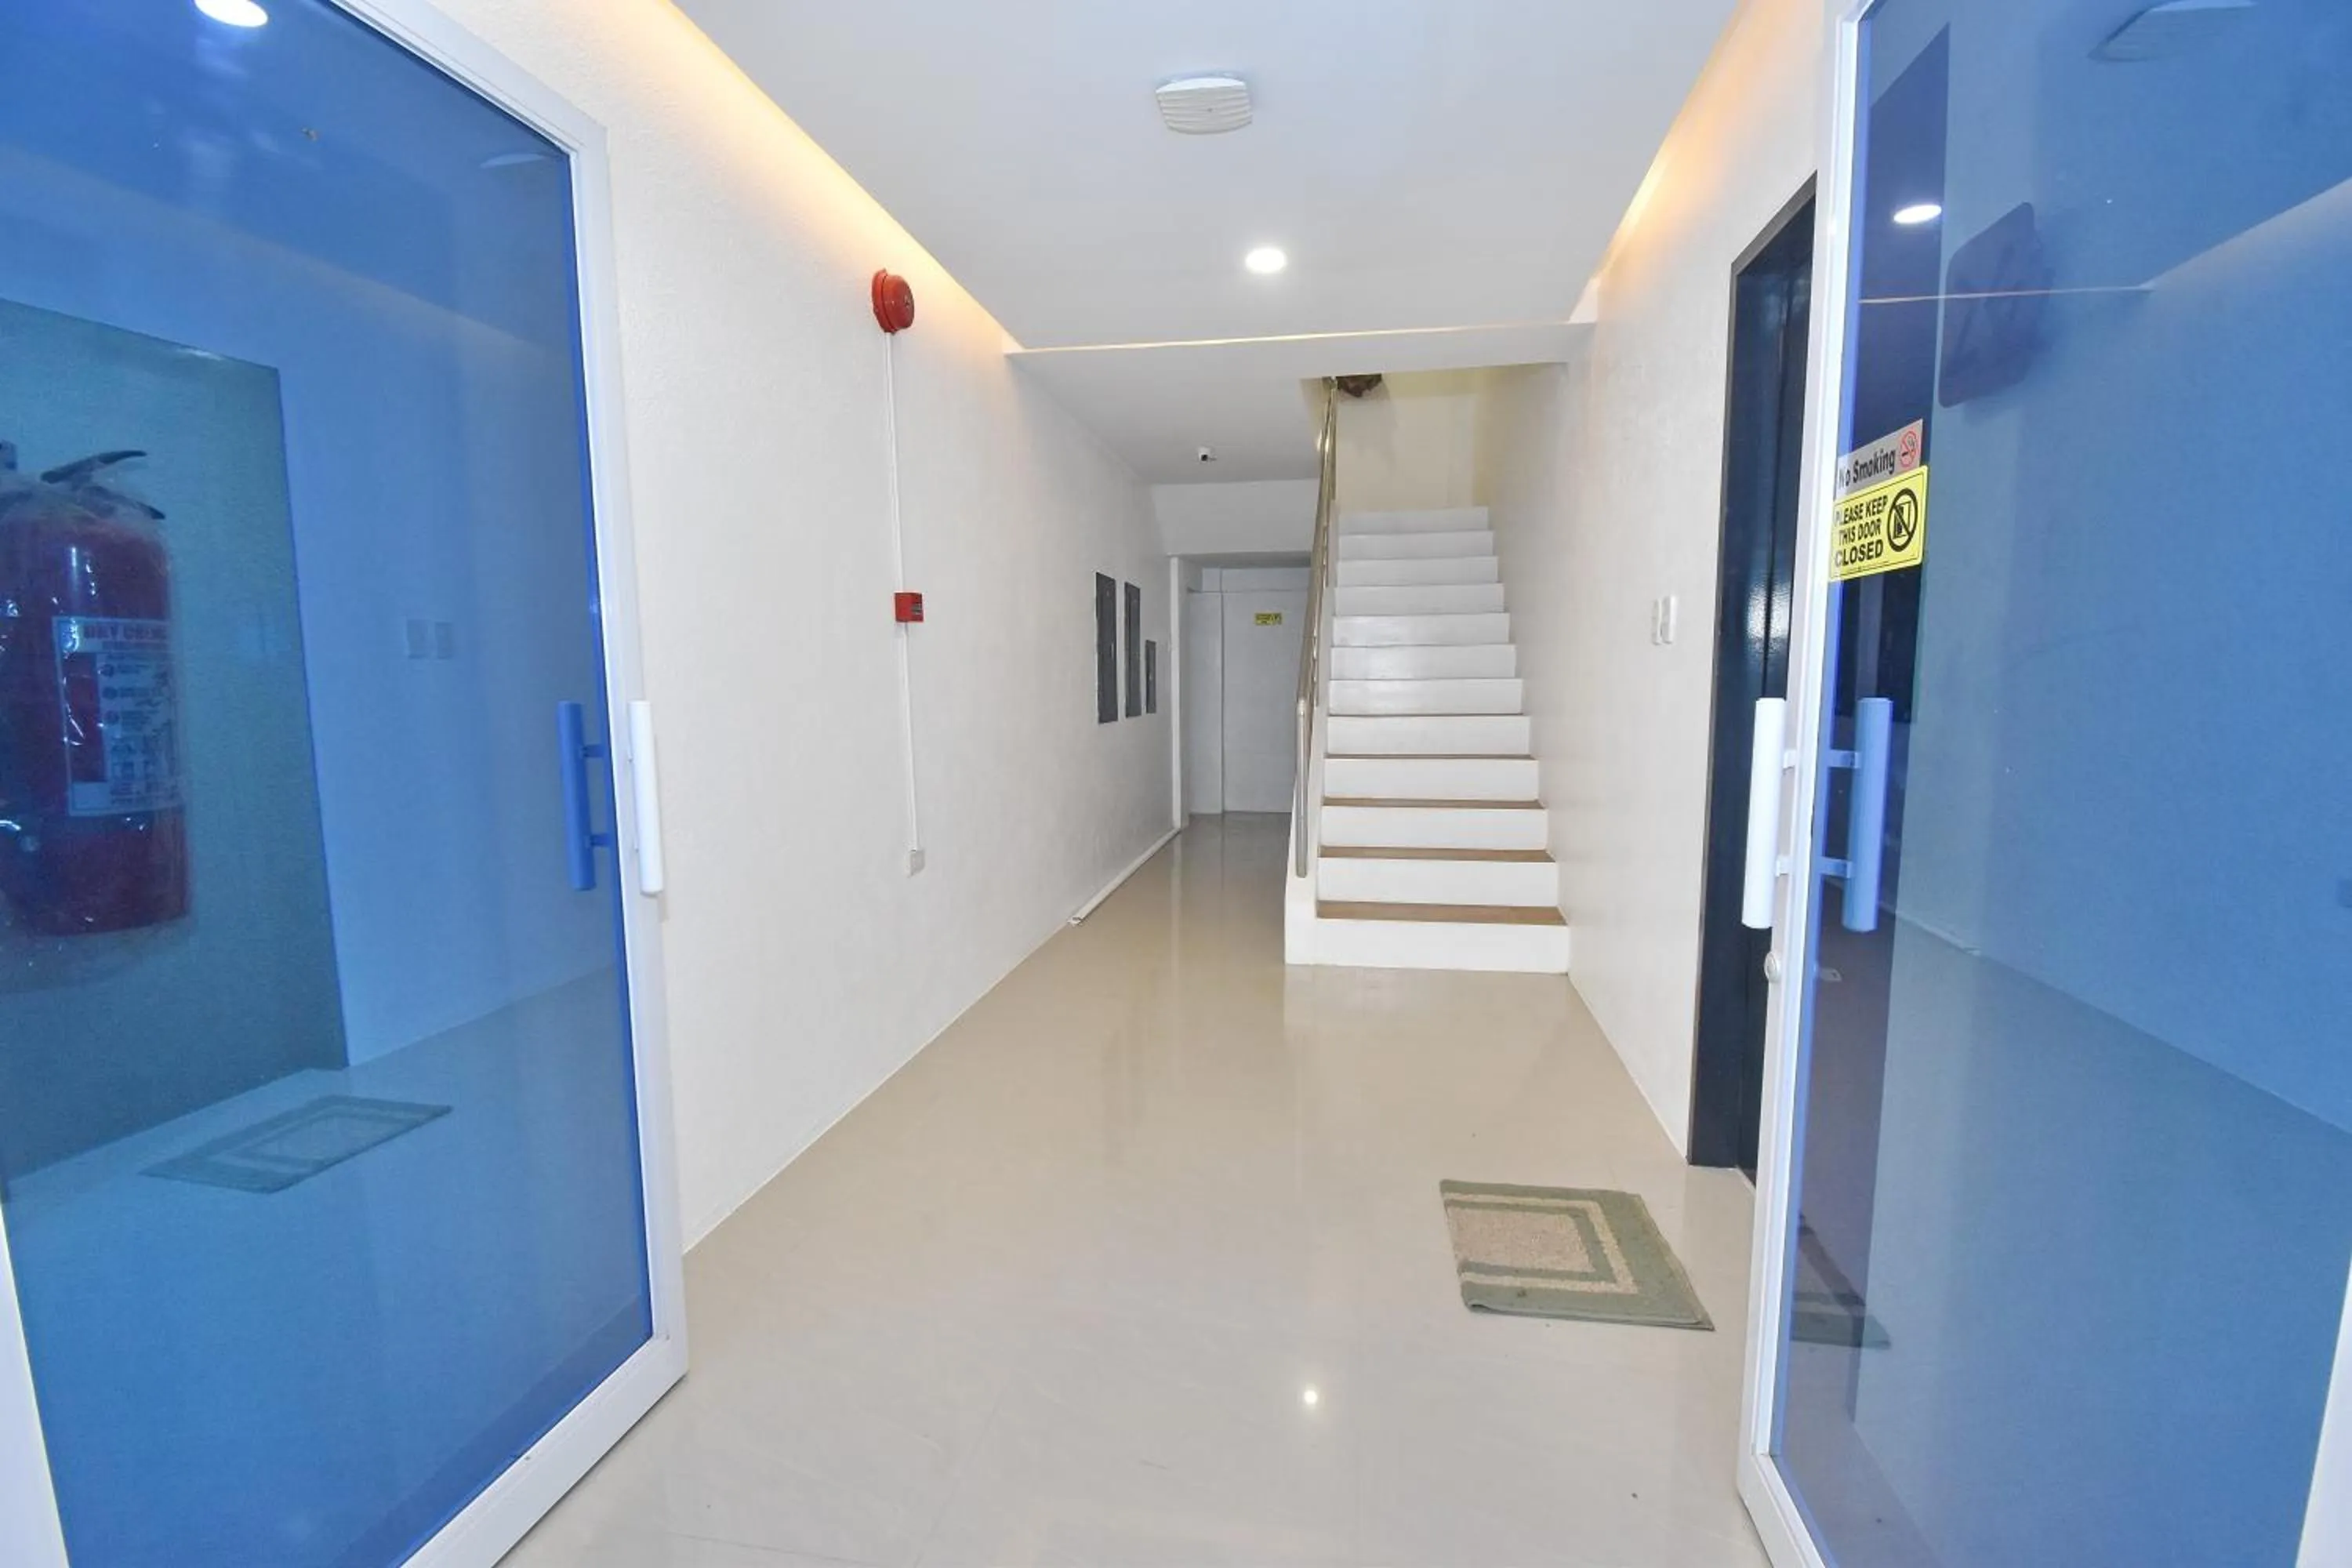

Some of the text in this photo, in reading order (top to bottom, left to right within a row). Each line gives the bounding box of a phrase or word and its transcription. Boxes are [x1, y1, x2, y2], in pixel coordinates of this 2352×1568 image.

[1852, 448, 1896, 484] Smoking
[1865, 495, 1888, 517] KEEP
[1838, 518, 1881, 546] THIS DOOR
[1835, 539, 1883, 567] CLOSED
